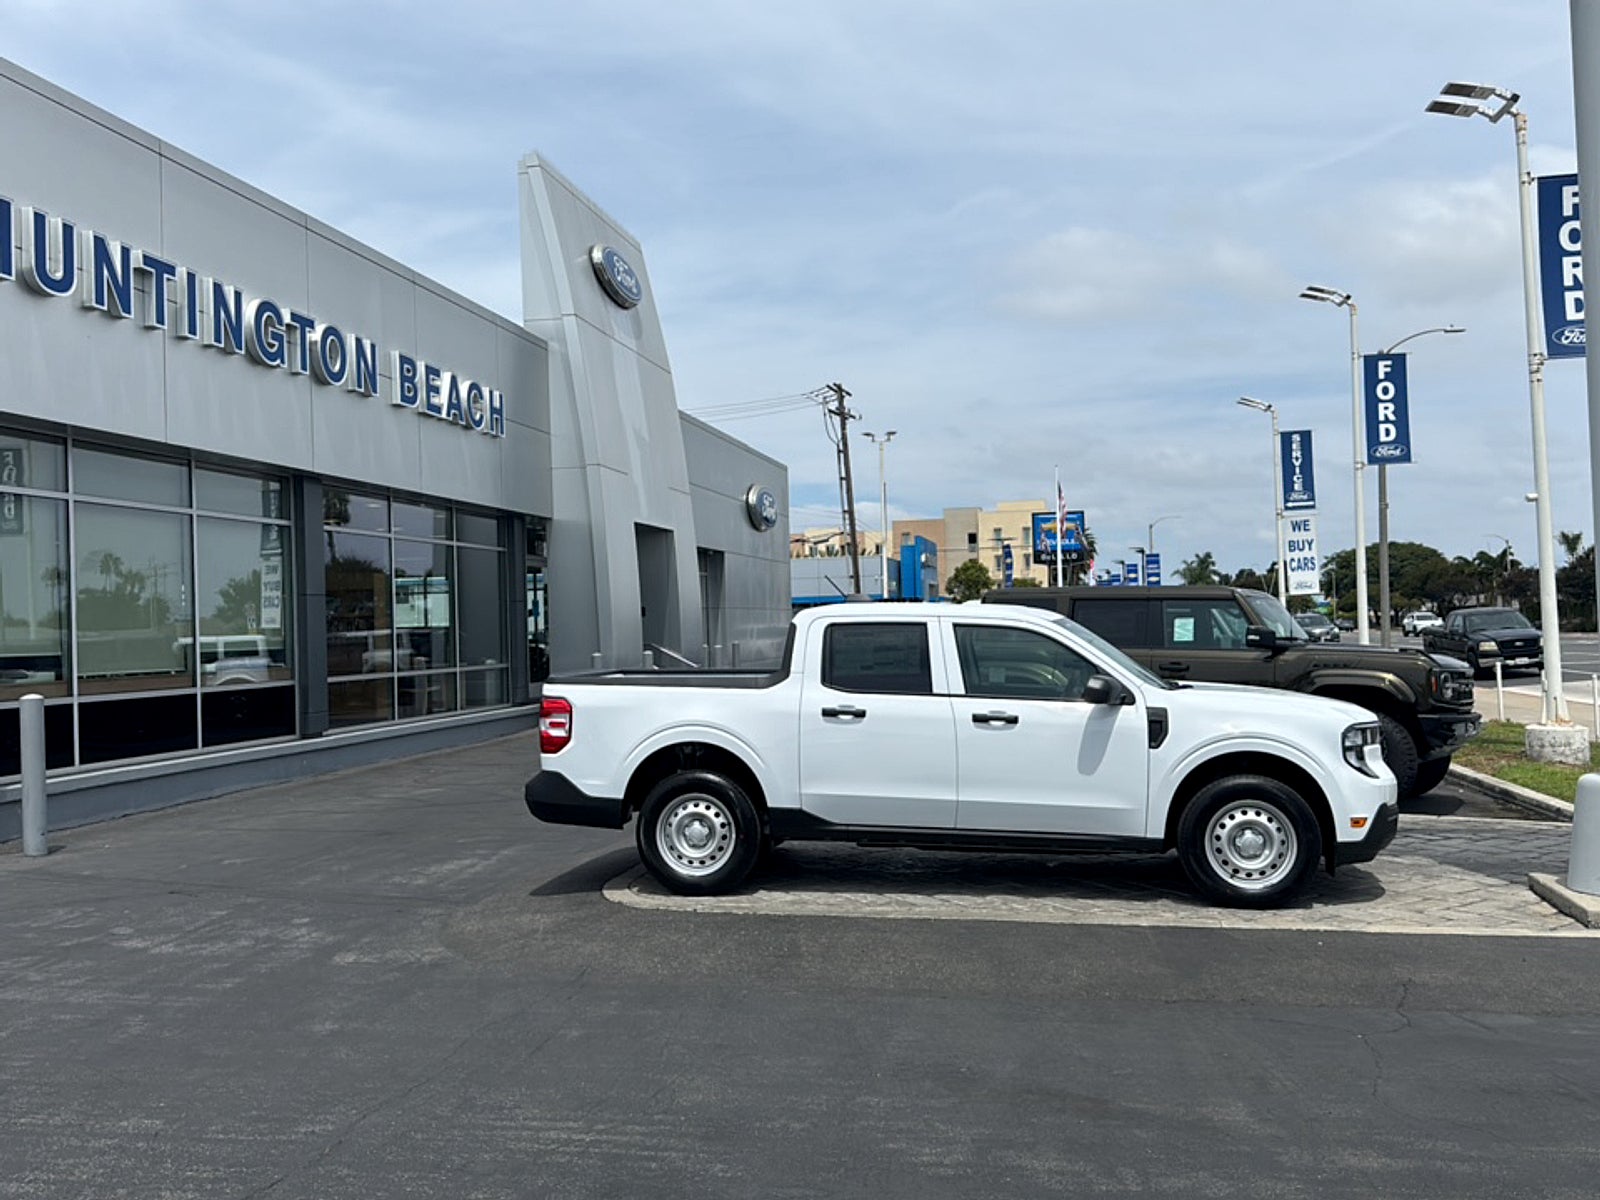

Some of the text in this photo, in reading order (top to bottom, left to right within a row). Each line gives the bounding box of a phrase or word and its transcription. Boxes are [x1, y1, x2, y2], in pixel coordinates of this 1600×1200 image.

[613, 255, 638, 294] Ford
[391, 351, 505, 437] BEACH
[1376, 360, 1396, 442] FORD
[1291, 433, 1302, 491] SERVICE
[1376, 445, 1402, 457] Ford
[1290, 519, 1311, 532] WE
[1288, 539, 1315, 552] BUY
[1289, 556, 1317, 572] CARS
